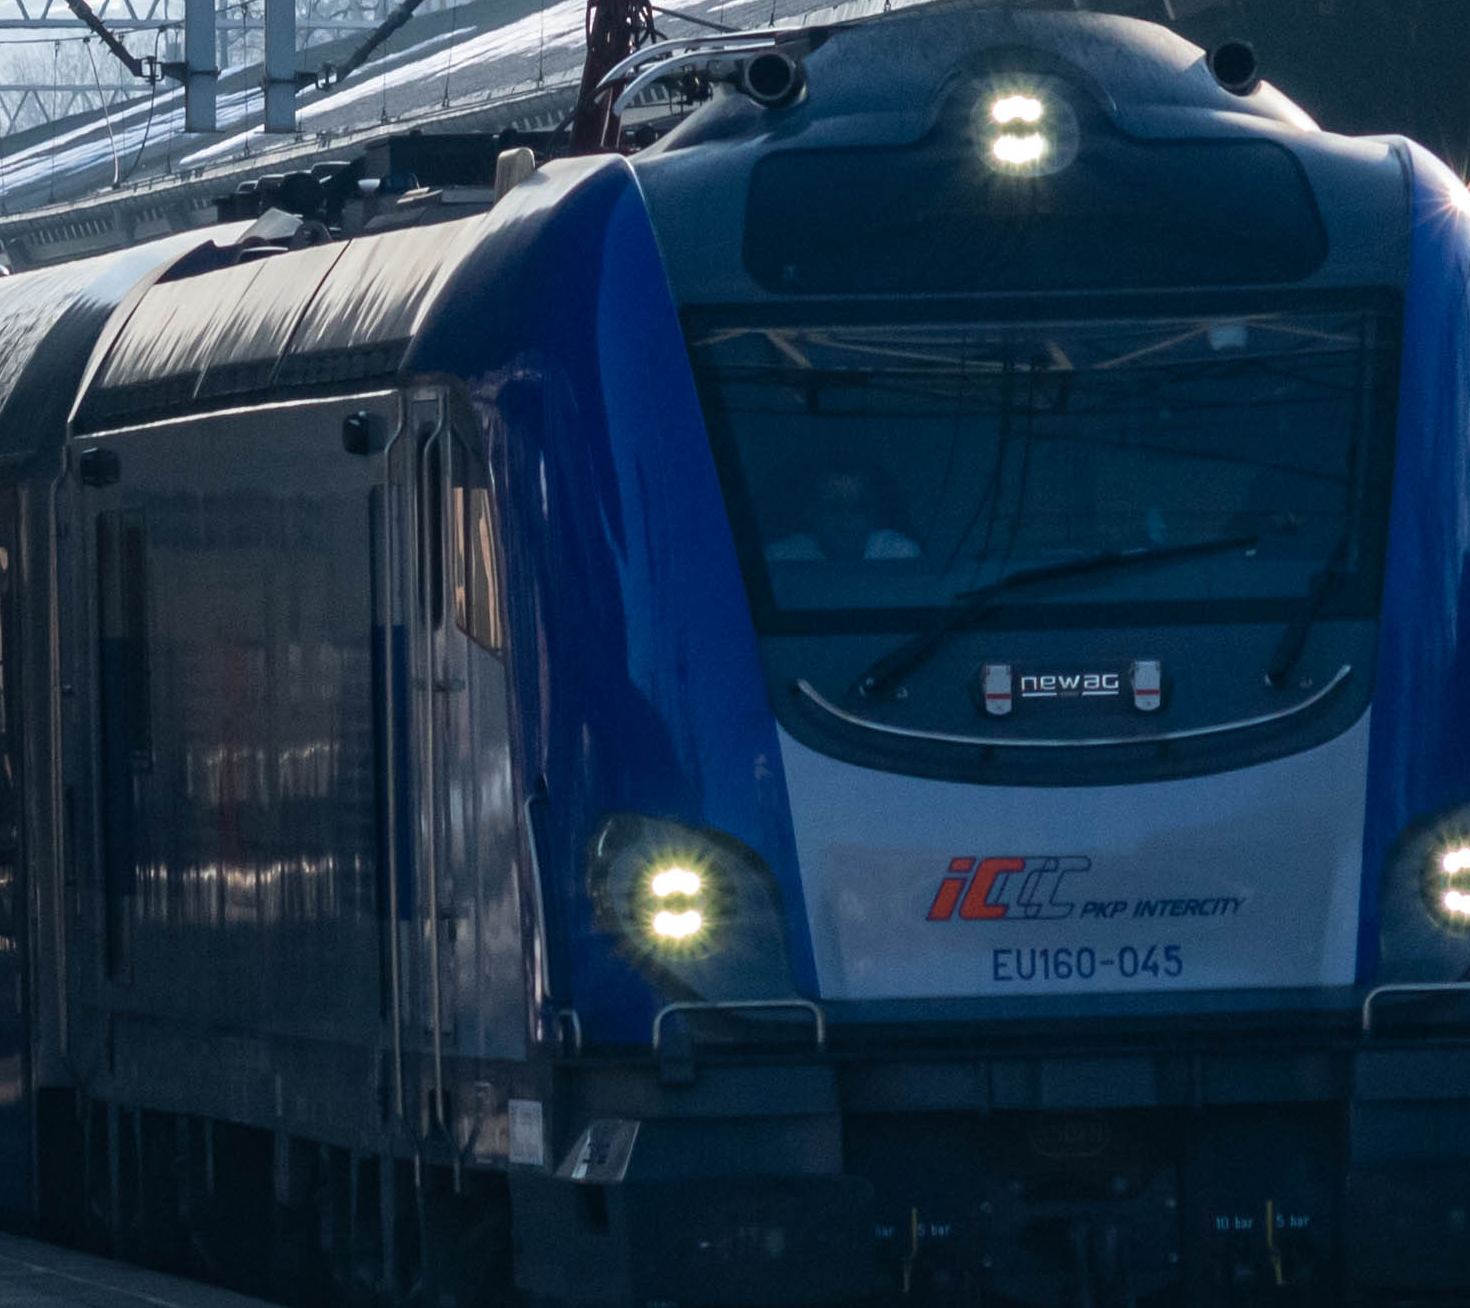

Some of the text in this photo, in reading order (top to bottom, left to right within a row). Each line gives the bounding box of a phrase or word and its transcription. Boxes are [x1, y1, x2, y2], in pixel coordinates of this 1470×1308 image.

[1079, 896, 1246, 919] PKP INTERCITY
[992, 944, 1184, 982] EU160-045
